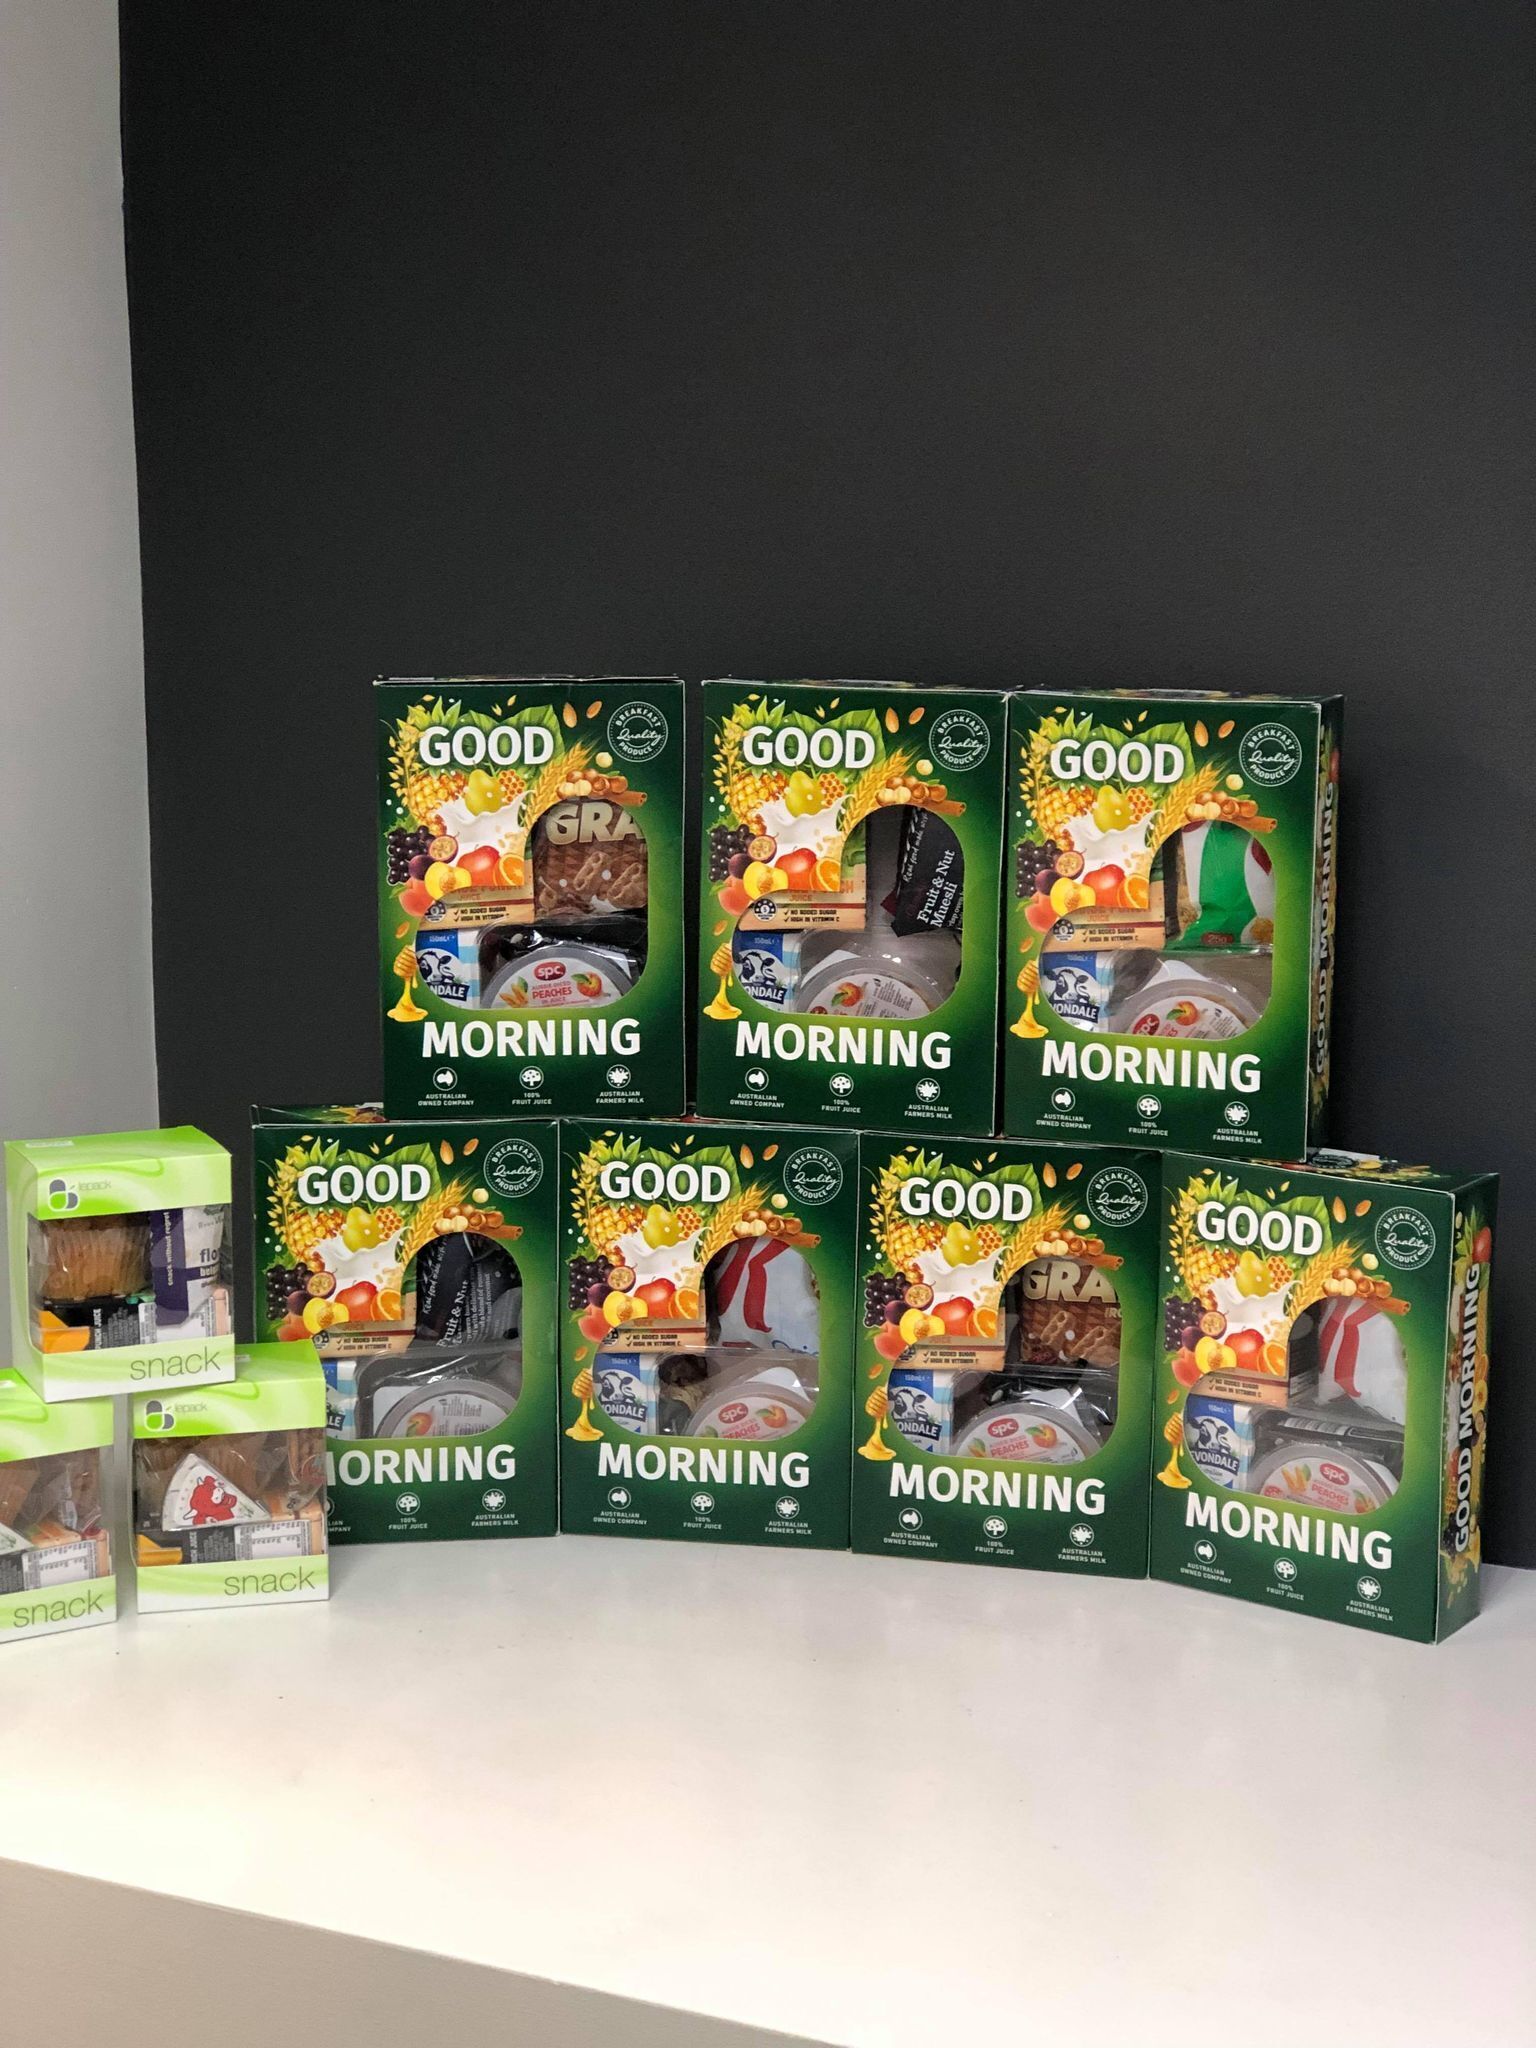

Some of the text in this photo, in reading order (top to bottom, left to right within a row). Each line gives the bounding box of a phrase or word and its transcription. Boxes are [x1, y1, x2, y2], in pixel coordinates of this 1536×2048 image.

[616, 708, 661, 726] BREAKFAST
[937, 716, 983, 735] BREAKFAST
[420, 726, 554, 766] GOOD
[617, 728, 664, 746] Quality
[743, 725, 875, 768] GOOD
[938, 736, 986, 756] Quality
[1248, 729, 1295, 749] BREAKFAST
[619, 742, 652, 756] PRODUCE
[940, 750, 973, 765] PRODUCE
[1050, 738, 1184, 783] GOOD
[1249, 750, 1298, 771] Quality
[1250, 765, 1284, 780] PRODUCE
[917, 850, 955, 924] Fruit & Nut
[930, 882, 958, 928] Muesli
[1316, 782, 1333, 1073] GOOD MORNING
[538, 965, 561, 980] spc
[430, 984, 465, 998] NDALE
[532, 987, 572, 1000] PEACHES
[745, 986, 784, 1000] ONDALE
[1054, 1003, 1097, 1019] ONDALE
[422, 1018, 640, 1058] MORNING
[735, 1021, 951, 1070] MORNING
[1042, 1040, 1261, 1093] MORNING
[1043, 1114, 1084, 1122] AUSTRALIAN
[492, 1145, 536, 1163] BREAKFAST
[791, 1152, 836, 1171] BREAKFAST
[493, 1164, 540, 1182] Quality
[600, 1160, 730, 1202] GOOD
[793, 1172, 840, 1191] Quality
[1095, 1173, 1141, 1192] BREAKFAST
[298, 1164, 431, 1204] GOOD
[495, 1178, 528, 1191] PRODUCE
[794, 1185, 827, 1199] PRODUCE
[901, 1177, 1032, 1221] GOOD
[1096, 1192, 1144, 1212] Quality
[1098, 1206, 1131, 1220] PRODUCE
[163, 1212, 172, 1234] regret
[1197, 1201, 1324, 1256] GOOD
[1384, 1213, 1430, 1236] BREAKFAST
[1384, 1233, 1430, 1256] Quality
[1386, 1246, 1418, 1263] PRODUCE
[451, 1306, 461, 1317] &
[130, 1346, 221, 1380] snack
[602, 1404, 645, 1418] ONDALE
[723, 1406, 744, 1421] spc
[1456, 1264, 1481, 1552] GOOD MORNING
[897, 1421, 938, 1437] ONDALE
[991, 1421, 1014, 1436] spc
[598, 1443, 809, 1488] MORNING
[1192, 1451, 1238, 1471] VONDALE
[1323, 1466, 1346, 1483] spc
[889, 1462, 1106, 1515] MORNING
[891, 1532, 931, 1540] AUSTRALIAN
[1186, 1492, 1392, 1570] MORNING
[1180, 1567, 1231, 1584] OWNED COMPANY
[1187, 1563, 1224, 1576] AUSTRALIAN
[224, 1566, 316, 1596] snack
[1266, 1587, 1304, 1601] FRUIT JUICE
[14, 1589, 104, 1628] snack
[1346, 1606, 1393, 1621] FARMERS MILK
[1350, 1600, 1390, 1613] AUSTRALIAN
